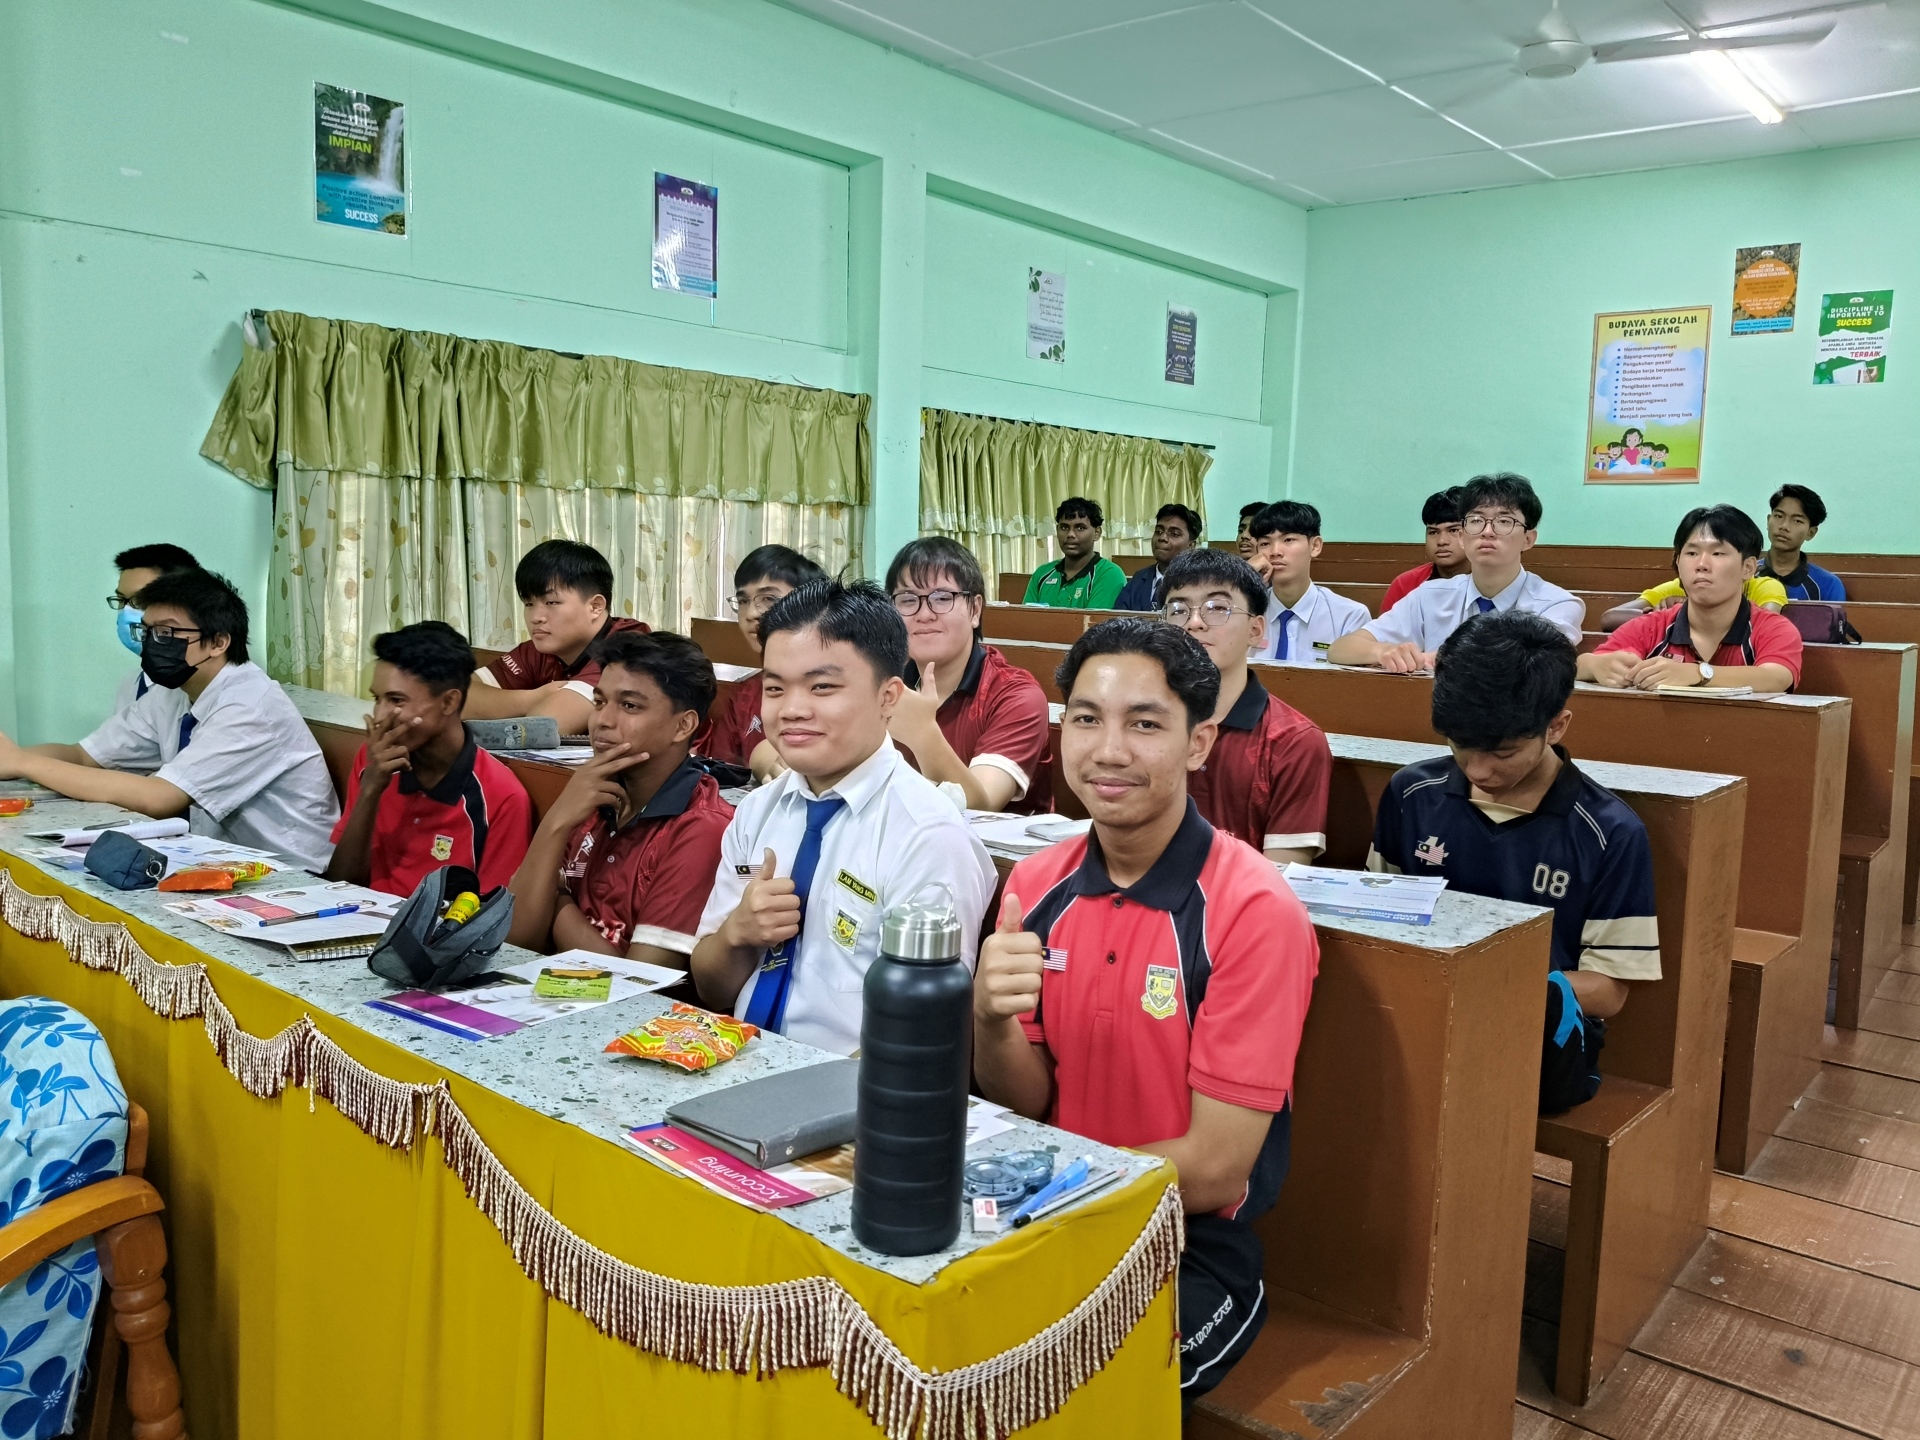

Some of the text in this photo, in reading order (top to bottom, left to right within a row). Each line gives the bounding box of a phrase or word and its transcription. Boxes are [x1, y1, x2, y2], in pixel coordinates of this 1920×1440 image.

[329, 135, 372, 154] IMPIAN
[322, 184, 400, 204] Positive action combined
[328, 192, 394, 210] with positive thinking
[346, 202, 368, 210] results
[345, 208, 378, 224] SUCCESS
[1609, 316, 1697, 329] BUDAYA SEKOLAH
[1836, 318, 1872, 327] SUCCESS
[1623, 326, 1680, 337] PENYAYANG
[1624, 344, 1677, 352] Hormat-menghormati
[1624, 352, 1674, 360] Sayang-menyayangi
[840, 873, 852, 886] LAM
[852, 881, 864, 894] YANG
[1532, 862, 1571, 899] 08
[1338, 910, 1390, 918] Foundation
